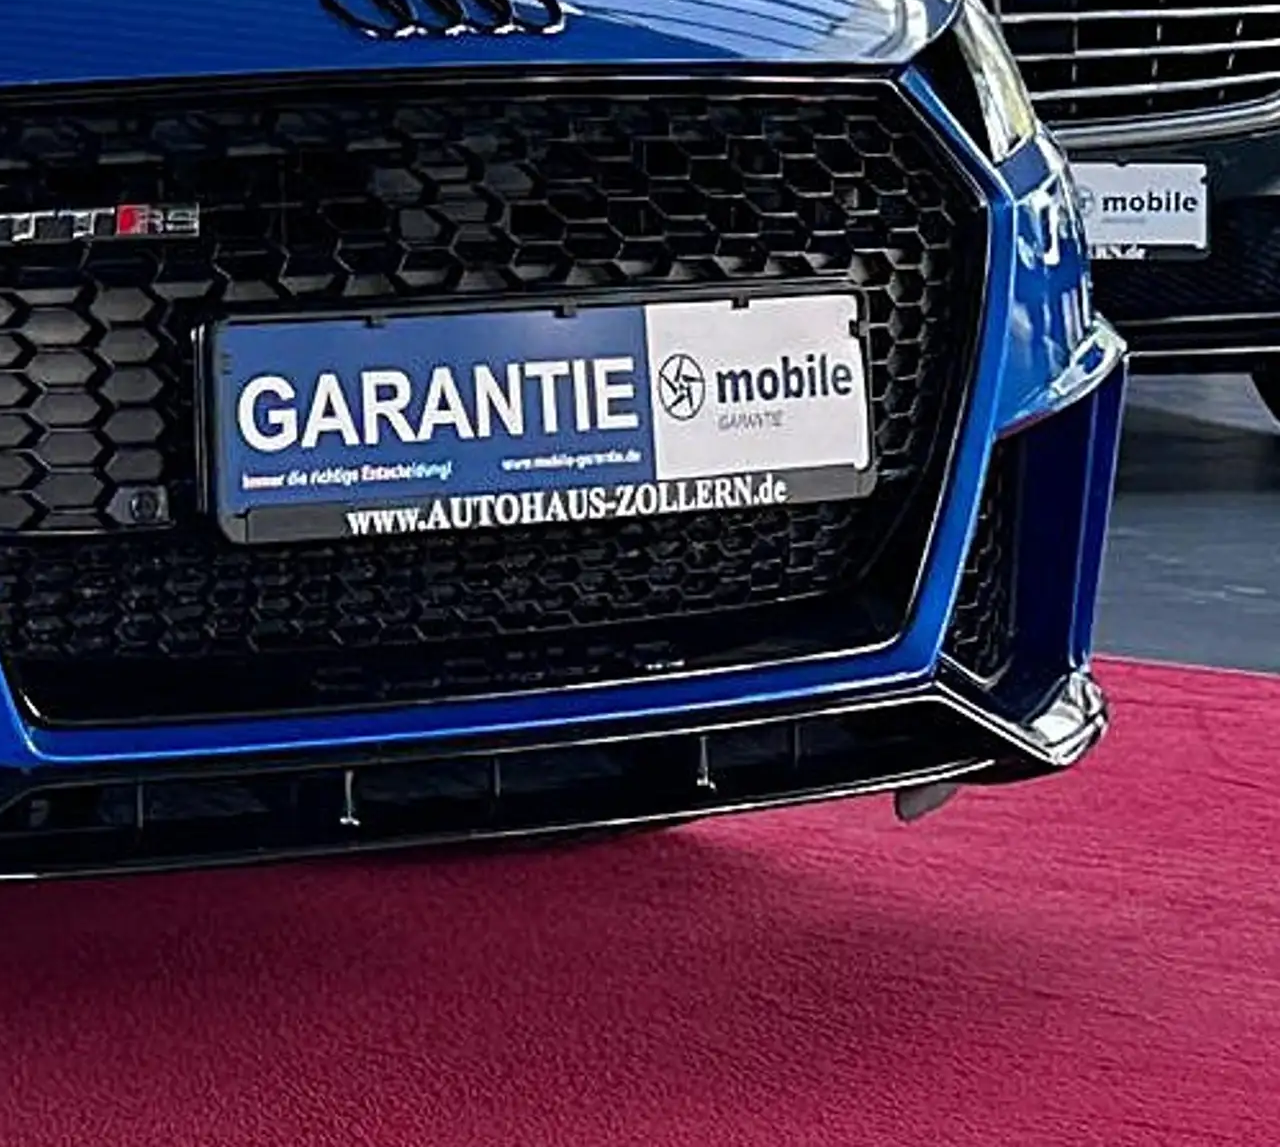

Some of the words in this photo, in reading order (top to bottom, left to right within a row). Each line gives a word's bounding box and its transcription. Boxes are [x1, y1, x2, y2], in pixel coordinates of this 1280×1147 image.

[1102, 190, 1198, 212] mobile
[237, 357, 639, 452] GARANTIE
[716, 354, 853, 403] mobile
[347, 474, 788, 536] www.AUTOHAUS-ZOLLERN.de
